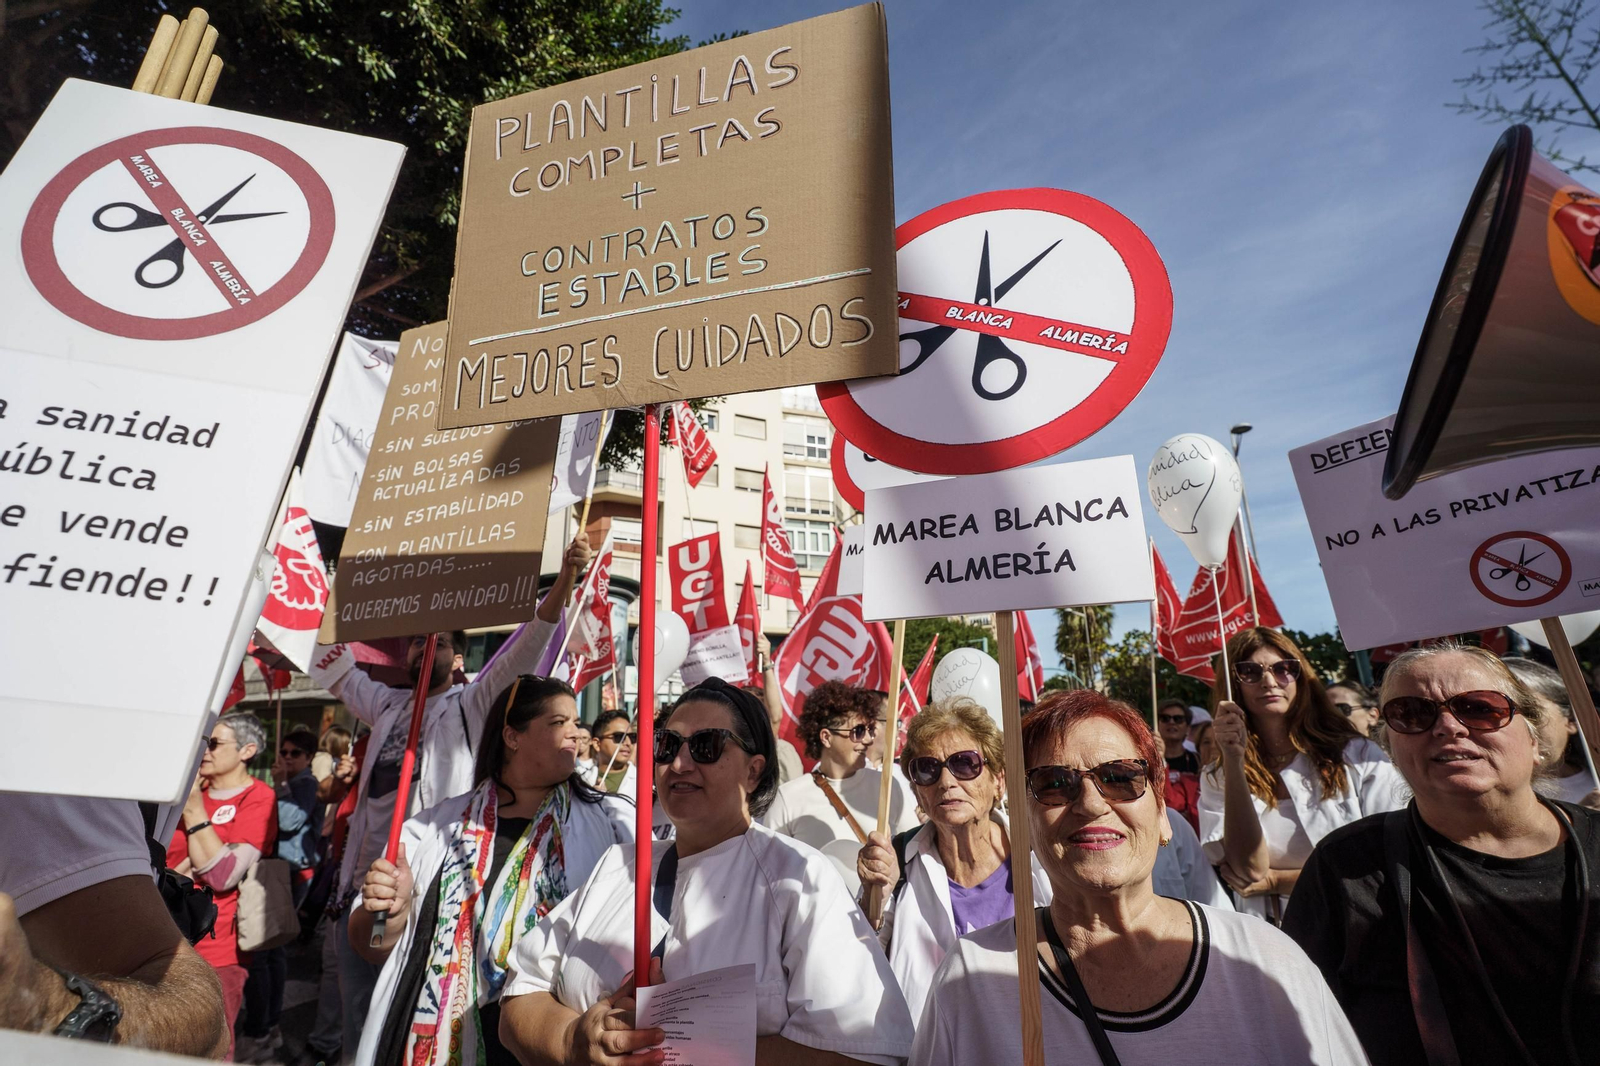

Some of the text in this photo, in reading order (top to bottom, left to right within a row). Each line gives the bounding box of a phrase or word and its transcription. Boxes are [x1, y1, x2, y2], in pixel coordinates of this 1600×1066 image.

[509, 107, 783, 197] COMPLETAS
[130, 154, 252, 306] MAREA BLANCA ALMERÍA
[521, 206, 769, 277] CONTRATOS
[536, 245, 768, 319] ESTABLES
[945, 306, 1130, 355] BLANCA ALMERÍA
[401, 378, 442, 397] SOM
[453, 335, 622, 410] MEJORES
[37, 404, 220, 449] sanidad
[391, 400, 435, 426] PRO
[0, 442, 157, 491] ública
[413, 449, 484, 477] BOLSAS
[1149, 443, 1209, 480] nidad
[60, 511, 189, 548] vende
[873, 497, 1129, 546] MAREA BLANCA
[1325, 529, 1361, 551] NO
[1371, 523, 1386, 539] A
[1393, 508, 1442, 533] LAS
[3, 552, 220, 607] fiende!!
[678, 539, 715, 632] UGT
[925, 542, 1077, 585] ALMERÍA
